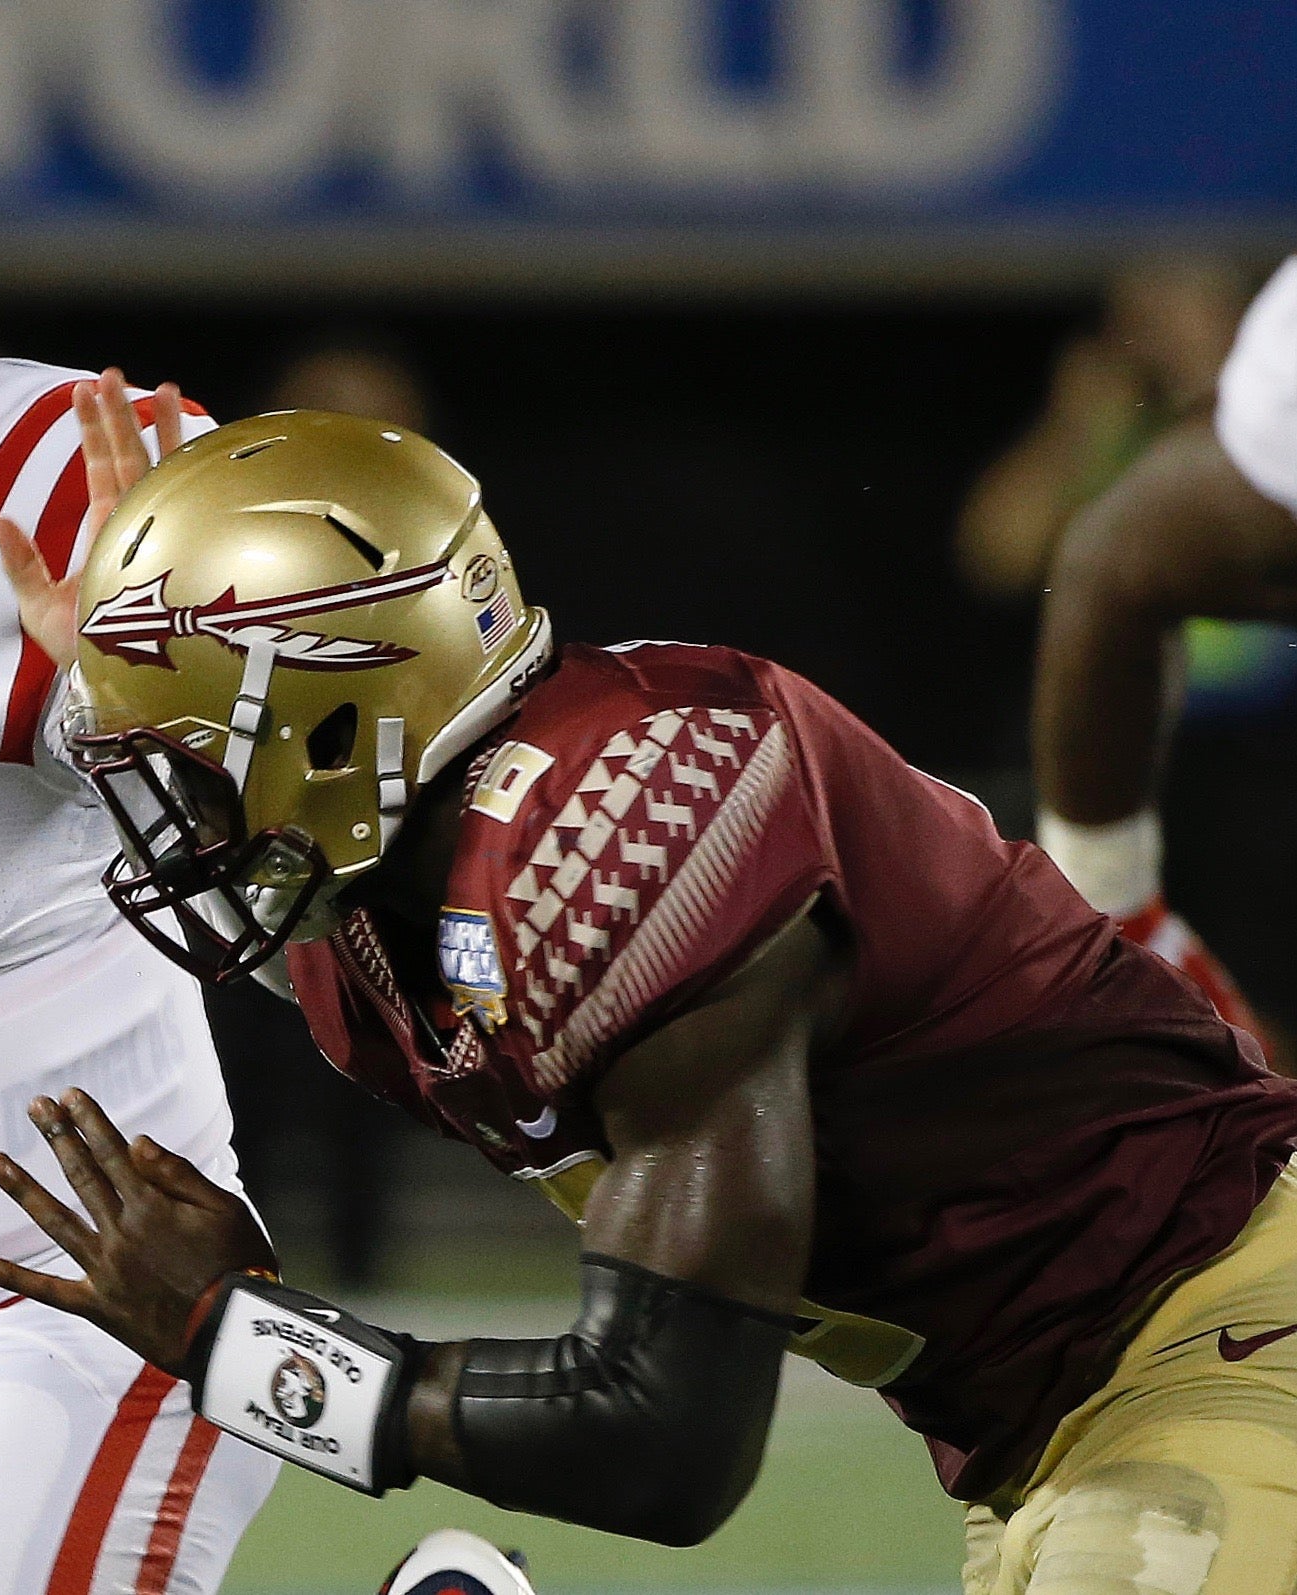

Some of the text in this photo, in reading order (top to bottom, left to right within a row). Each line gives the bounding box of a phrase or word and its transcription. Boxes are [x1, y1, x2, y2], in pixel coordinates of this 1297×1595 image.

[251, 1318, 361, 1384] OUR DEFENSE
[244, 1400, 340, 1455] OUR TEAM
